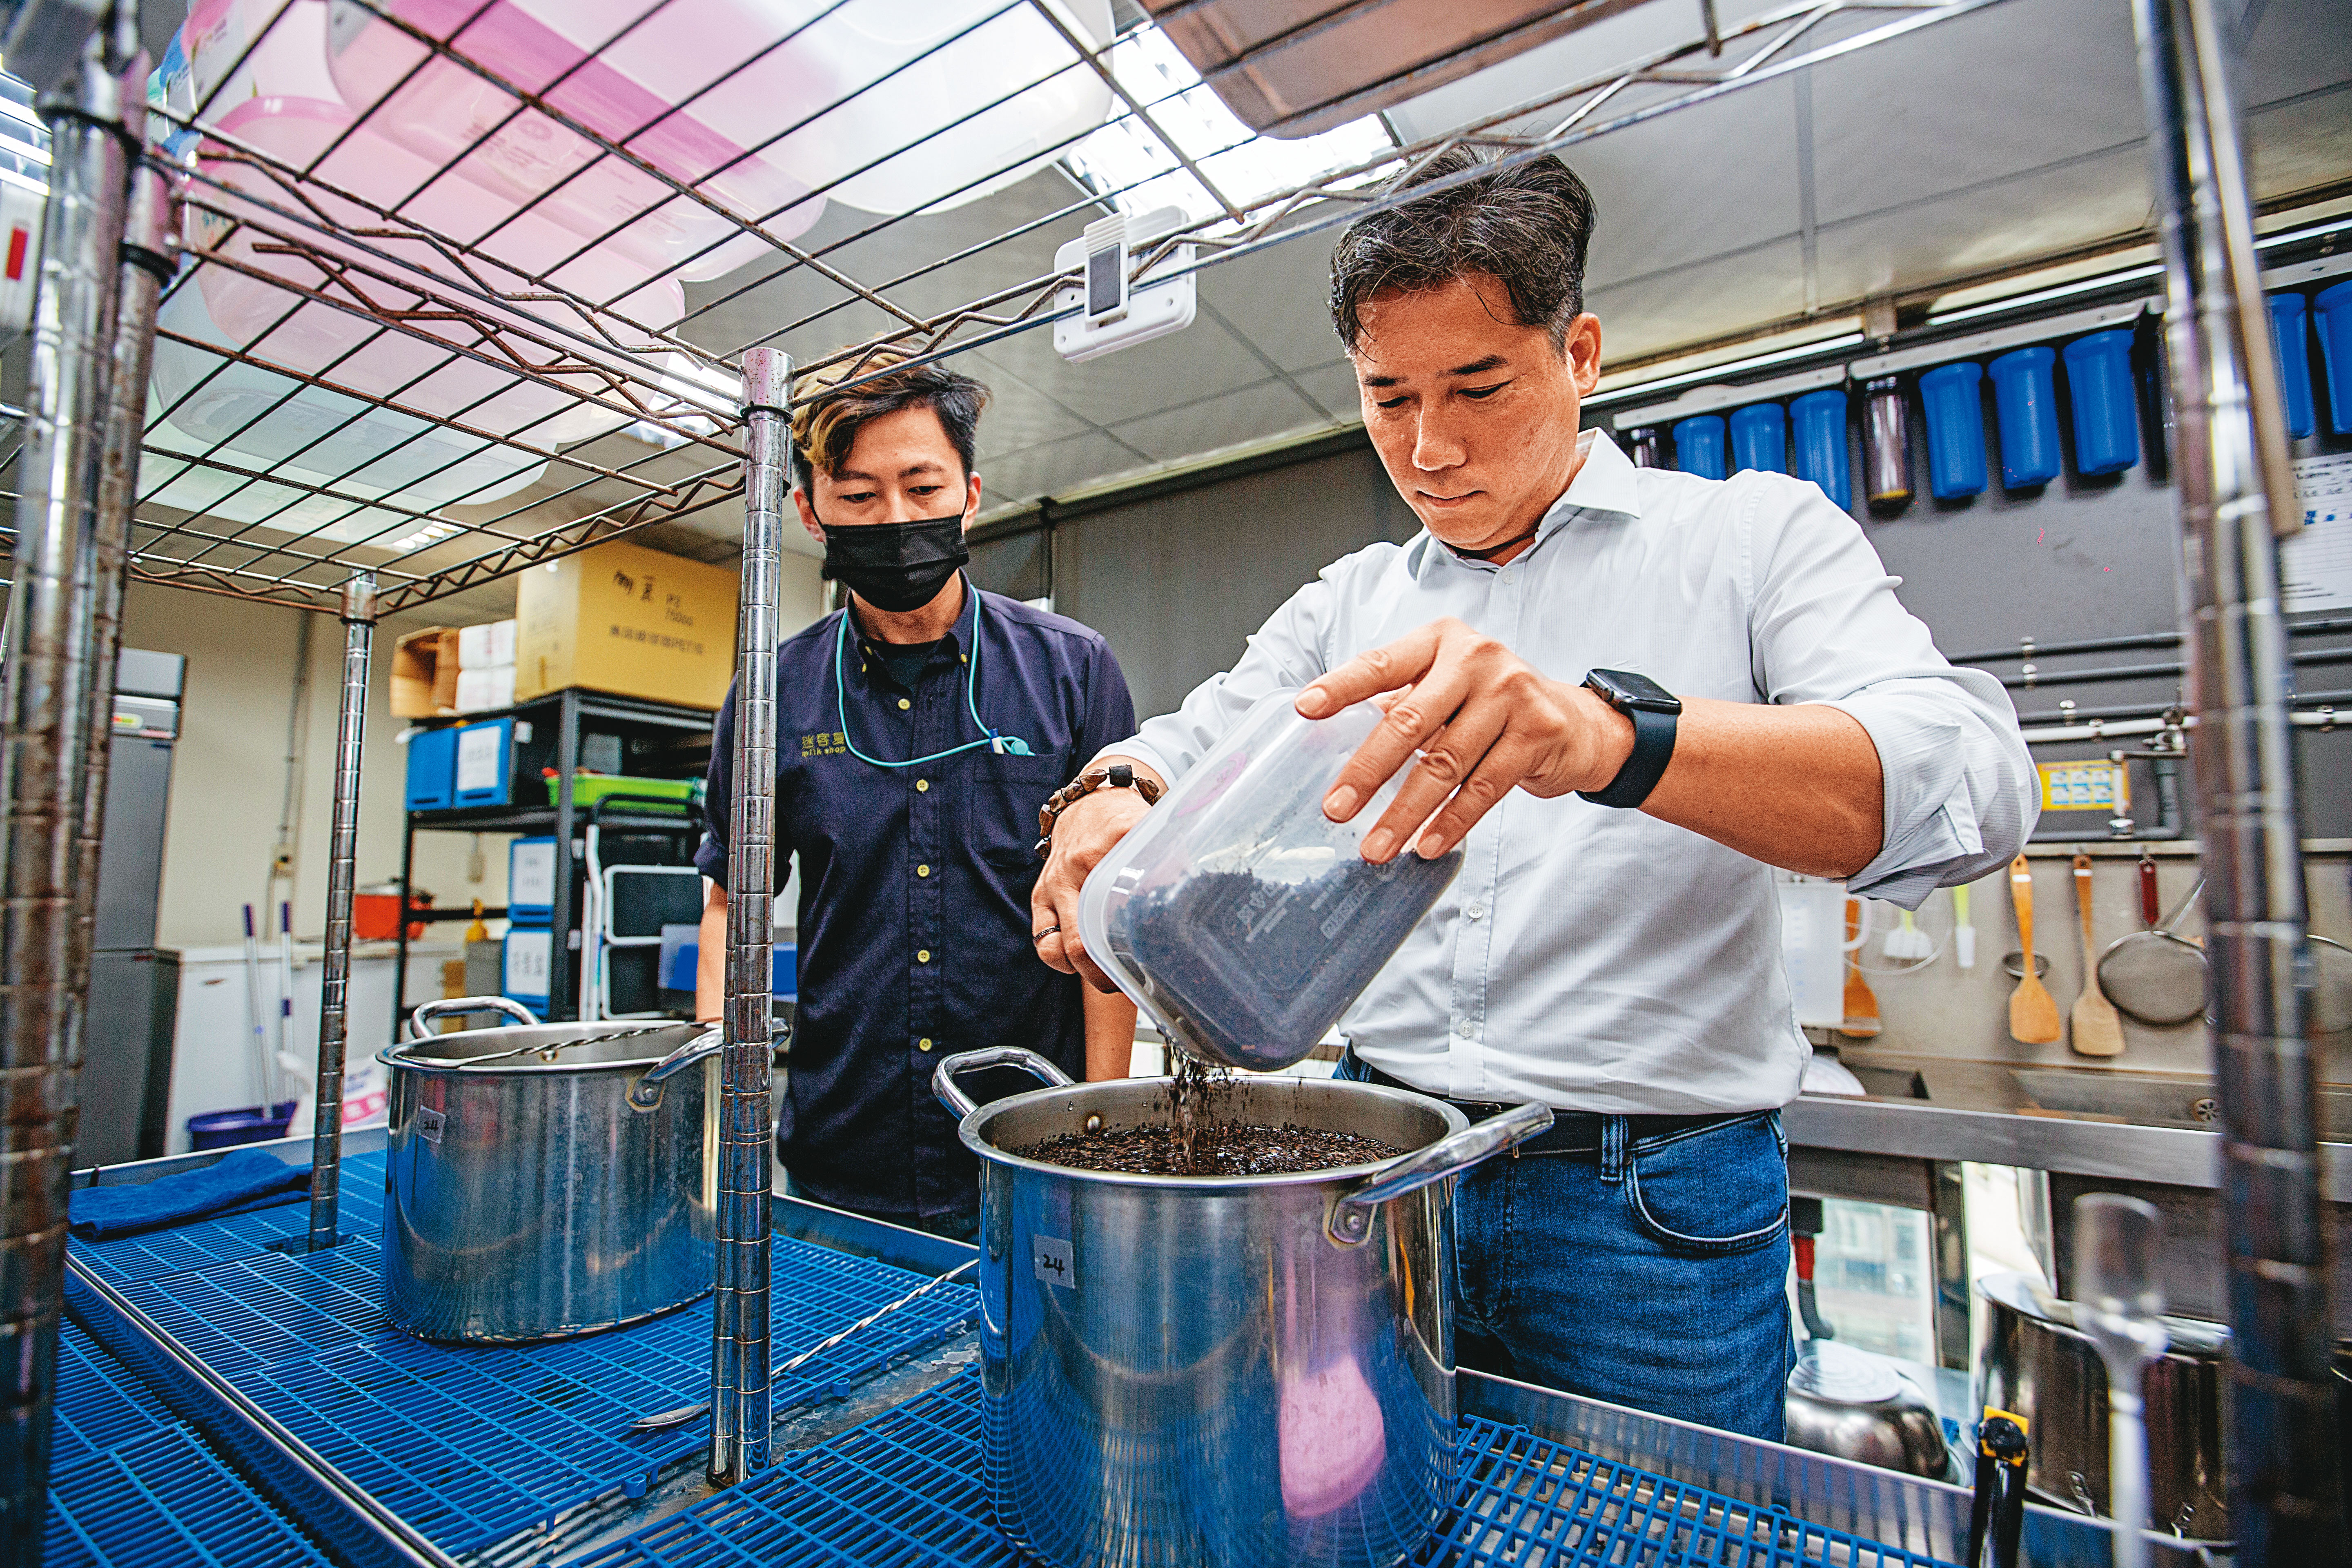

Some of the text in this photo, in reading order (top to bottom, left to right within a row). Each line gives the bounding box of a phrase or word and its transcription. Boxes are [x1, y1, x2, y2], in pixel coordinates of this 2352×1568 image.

[802, 732, 844, 750] 迷客夏
[802, 746, 846, 757] milk shop
[423, 1120, 439, 1131] 24
[1043, 1253, 1065, 1277] 24
